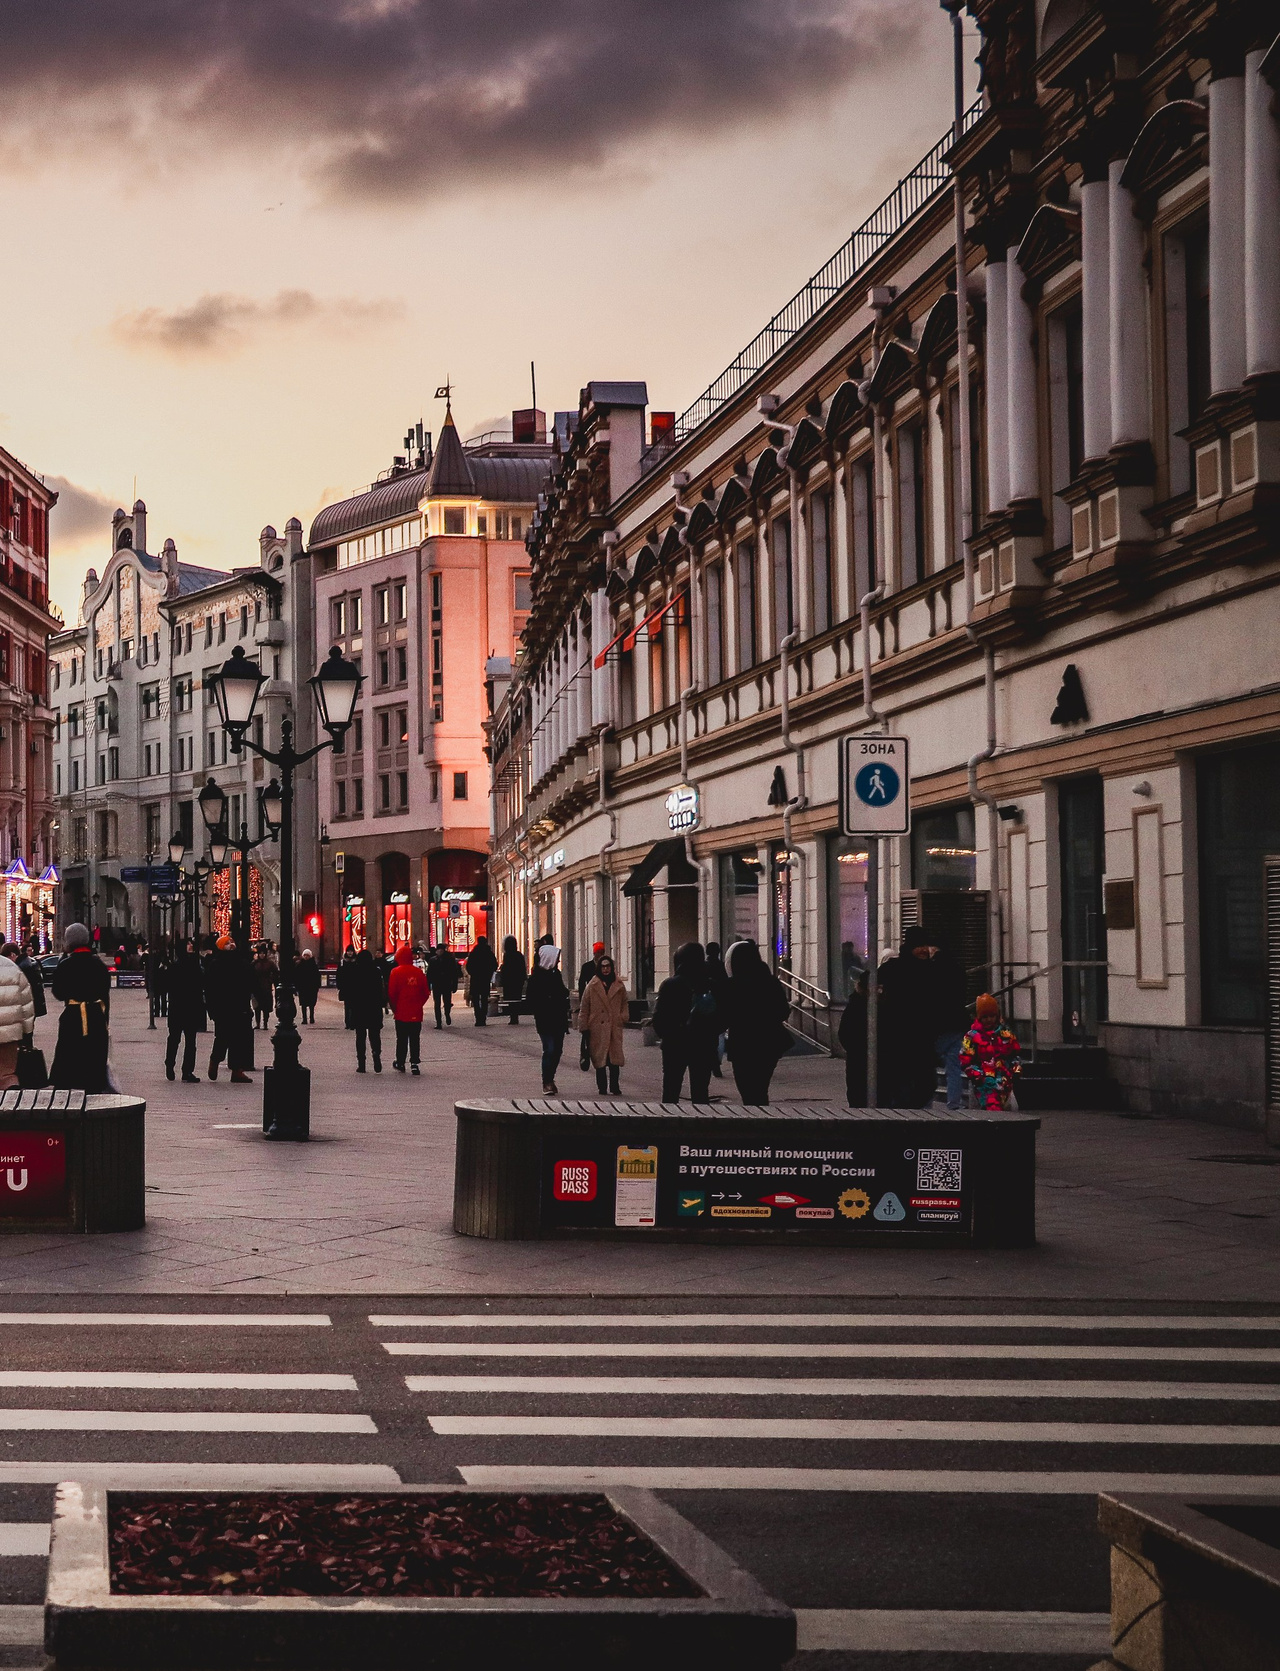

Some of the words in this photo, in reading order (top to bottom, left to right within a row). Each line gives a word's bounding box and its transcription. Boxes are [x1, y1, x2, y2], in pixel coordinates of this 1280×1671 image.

[860, 743, 896, 755] ЗОНА
[441, 889, 474, 901] Cartier
[47, 1138, 60, 1146] 0+
[680, 1145, 712, 1157] Ваш
[715, 1146, 772, 1158] личный
[775, 1150, 853, 1161] помощник
[561, 1167, 589, 1180] RUSS
[679, 1165, 688, 1174] в
[691, 1165, 798, 1177] путешествиях
[800, 1167, 818, 1176] по
[822, 1164, 875, 1177] России
[561, 1181, 589, 1194] PASS
[912, 1199, 958, 1207] russpass.ru
[713, 1206, 769, 1215] вдохновляйся
[798, 1208, 832, 1217] покупай
[920, 1212, 959, 1221] планируй
